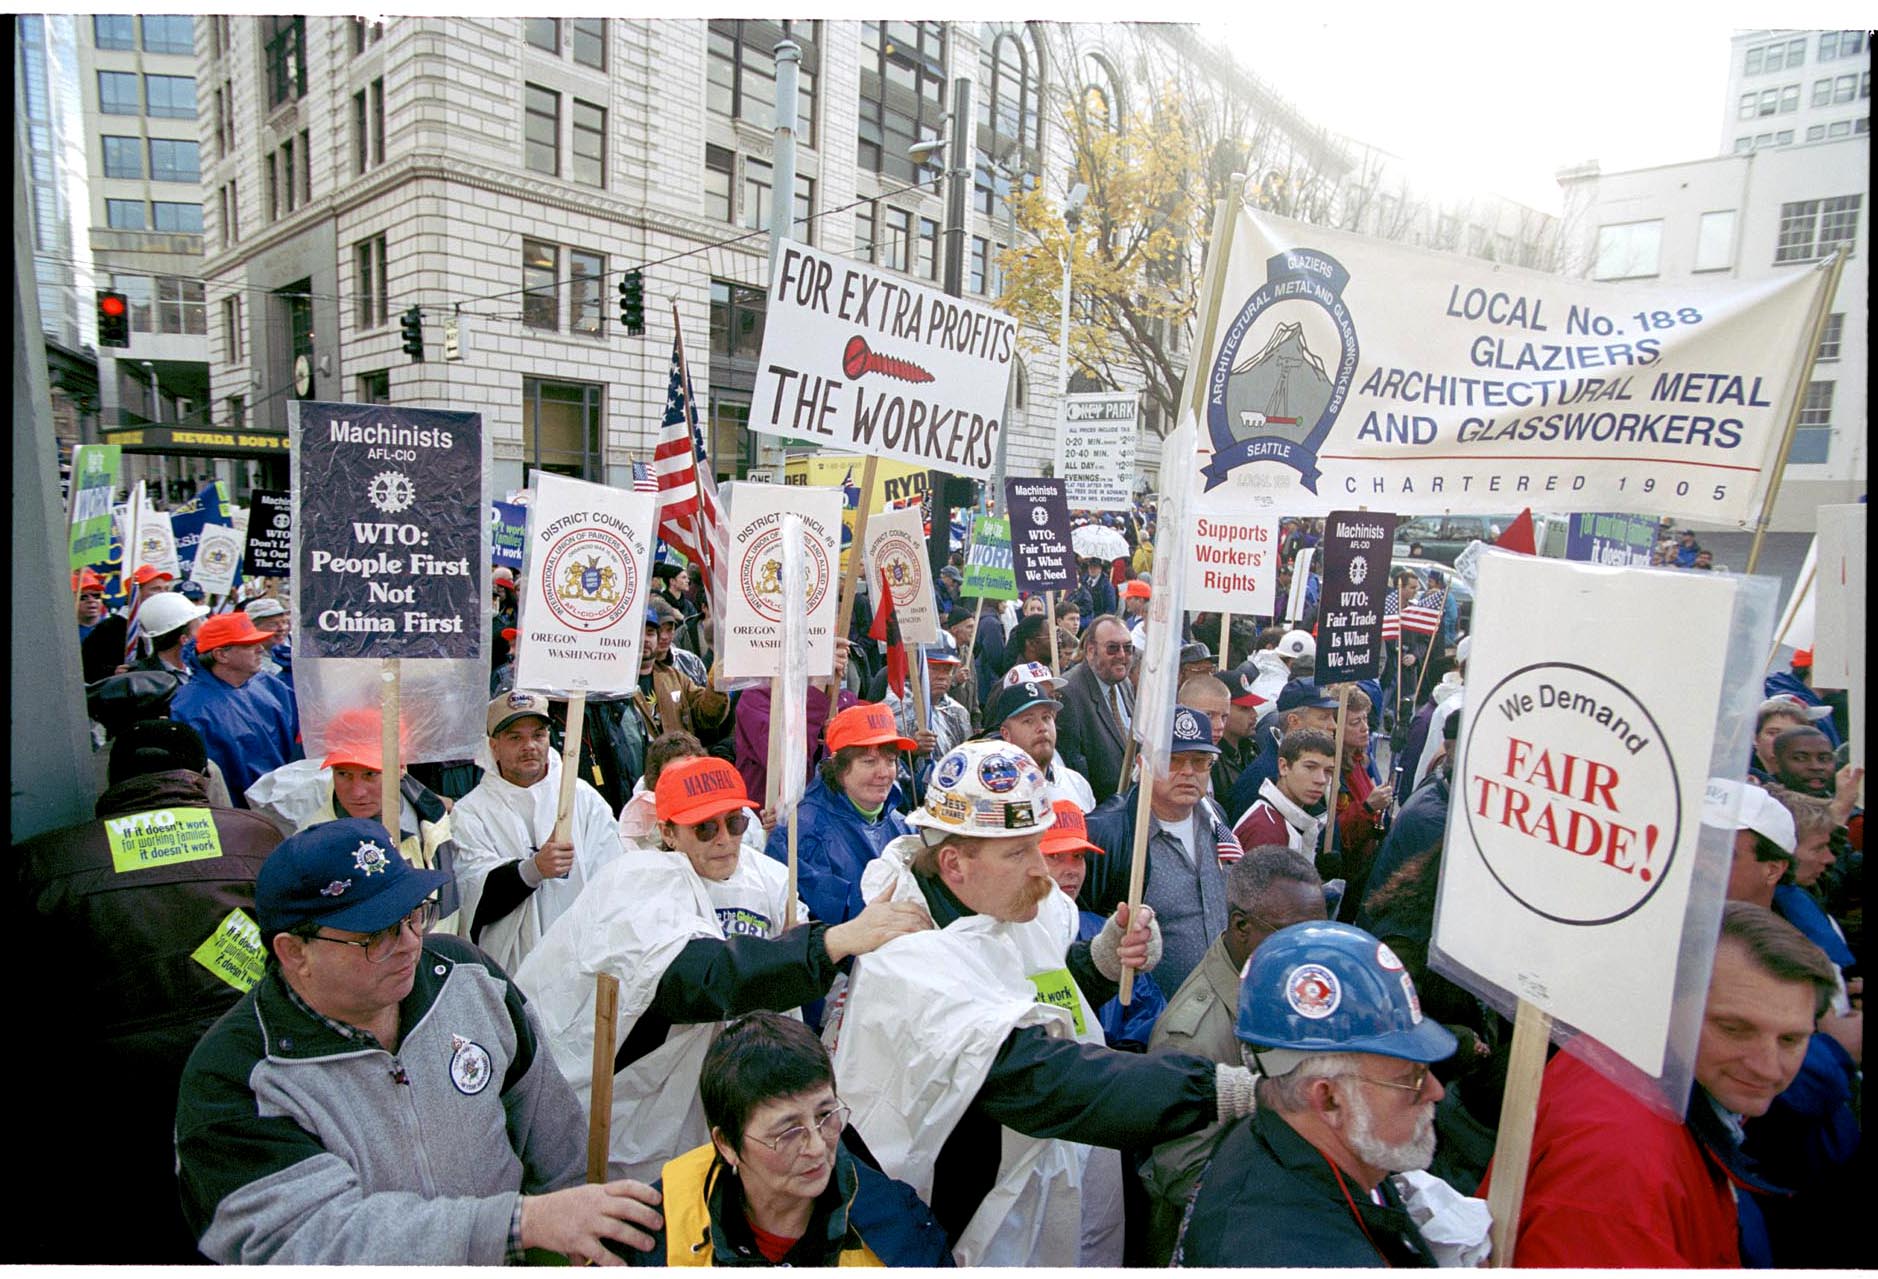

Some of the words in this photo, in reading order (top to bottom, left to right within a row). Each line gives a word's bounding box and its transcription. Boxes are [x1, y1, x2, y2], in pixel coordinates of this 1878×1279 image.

[1288, 255, 1333, 278] GLAZIERS
[778, 248, 833, 314] FOR
[838, 270, 924, 343] EXTRA
[926, 299, 1015, 364] PROFITS
[1446, 284, 1548, 332] LOCAL
[1566, 305, 1624, 336] No.
[1632, 307, 1703, 333] 188
[1212, 291, 1271, 405] ARCHITECTURAL
[1275, 280, 1312, 297] METAL
[1314, 283, 1334, 306] AND
[1329, 304, 1356, 413] GLASSWORKERS
[1359, 367, 1634, 408] ARCHITECTURAL
[1650, 373, 1772, 407] METAL
[768, 365, 842, 435] THE
[852, 386, 999, 469] WORKERS
[1105, 402, 1135, 419] PARK
[172, 431, 236, 446] NEVADA
[239, 435, 279, 447] BOB'S
[330, 420, 453, 448] Machinists
[1357, 411, 1438, 445] AND
[1456, 413, 1744, 449] GLASSWORKERS
[367, 448, 416, 461] AFL-CIO
[1247, 442, 1291, 458] SEATTLE
[785, 473, 807, 486] DER
[884, 471, 927, 502] RYD
[1345, 474, 1586, 493] CHARTERED
[1617, 477, 1726, 501] 1905
[1015, 485, 1058, 496] Machinists
[353, 522, 429, 546] WTO:
[541, 512, 589, 542] DISTRICT
[592, 512, 634, 542] COUNCIL
[635, 541, 645, 556] #5
[576, 532, 587, 541] OF
[737, 512, 781, 544] DISTRICT
[785, 512, 825, 537] UNCIL
[825, 536, 835, 548] #5
[769, 531, 779, 540] OF
[1028, 529, 1055, 541] WTO:
[1197, 519, 1268, 543] Supports
[1336, 522, 1384, 539] Machinists
[250, 538, 277, 548] Don't
[555, 536, 576, 555] UNION
[588, 531, 621, 550] PAINTERS
[752, 535, 770, 553] UNION
[870, 532, 888, 557] DISTRICT
[889, 530, 912, 543] COUNCIL
[1019, 544, 1039, 554] Fair
[1041, 543, 1066, 553] Trade
[1350, 541, 1370, 549] AFL-CIO
[255, 550, 267, 559] Us
[269, 551, 288, 559] Out
[620, 549, 631, 565] AND
[811, 544, 822, 558] AND
[1196, 544, 1267, 567] Workers'
[255, 558, 274, 567] The
[311, 551, 402, 578] People
[410, 553, 470, 576] First
[1027, 557, 1036, 567] Is
[1038, 556, 1062, 567] What
[626, 565, 634, 594] ALLIED
[743, 556, 762, 609] INTERNATIONAL
[1025, 571, 1041, 581] We
[1043, 569, 1067, 580] Need
[1204, 571, 1256, 593] Rights
[368, 581, 415, 603] Not
[544, 556, 564, 615] INTERNATIONAL
[808, 586, 824, 609] TRADE
[1341, 591, 1368, 607] WTO:
[609, 595, 631, 621] TRADES
[318, 609, 396, 632] China
[403, 612, 463, 633] First
[1326, 612, 1347, 628] Fair
[1350, 611, 1376, 626] Trade
[531, 632, 577, 645] OREGON
[600, 637, 631, 648] IDAHO
[733, 626, 776, 635] OREGON
[807, 626, 826, 635] AHO
[1332, 633, 1341, 647] Is
[1343, 630, 1369, 646] What
[750, 638, 814, 649] WASHIN
[549, 649, 617, 661] WASHINGTON
[1328, 652, 1345, 667] We
[1346, 650, 1370, 665] Need
[1499, 693, 1533, 722] We
[1539, 684, 1649, 756] Demand
[1503, 737, 1621, 813] FAIR
[108, 811, 175, 835] WTO
[123, 828, 131, 838] If
[135, 827, 142, 836] it
[146, 821, 184, 835] doesn't
[186, 818, 209, 829] work
[1474, 775, 1659, 882] TRADE!
[122, 839, 135, 853] for
[139, 834, 175, 848] working
[177, 829, 211, 841] families
[140, 849, 148, 860] it
[151, 843, 189, 859] doesn't
[191, 840, 215, 852] work
[723, 910, 736, 921] the
[1048, 985, 1072, 1002] work
